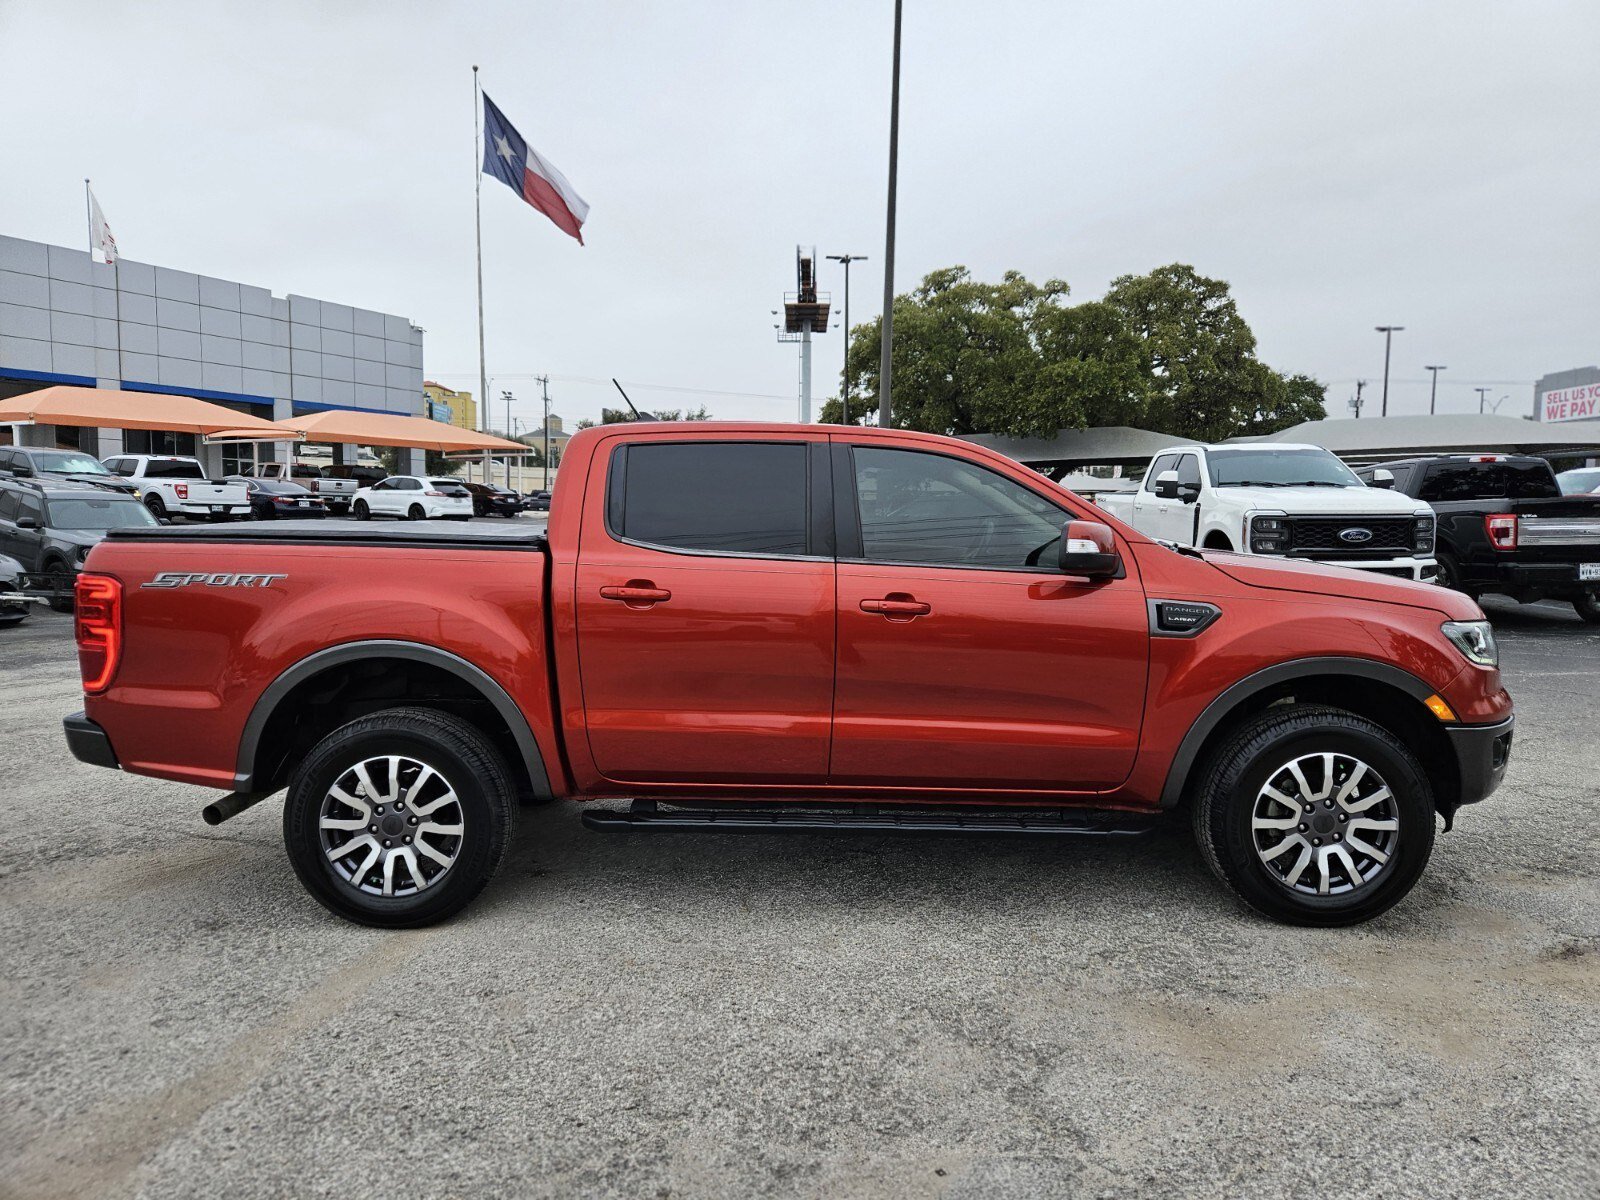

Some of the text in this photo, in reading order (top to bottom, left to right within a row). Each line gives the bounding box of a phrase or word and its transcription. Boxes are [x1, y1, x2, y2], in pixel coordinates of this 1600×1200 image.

[1547, 391, 1569, 404] SELL
[1572, 388, 1585, 400] US
[1547, 400, 1596, 420] WE PAY
[1347, 531, 1366, 540] Ford
[140, 572, 289, 589] SPORT
[1165, 606, 1210, 614] RANGER
